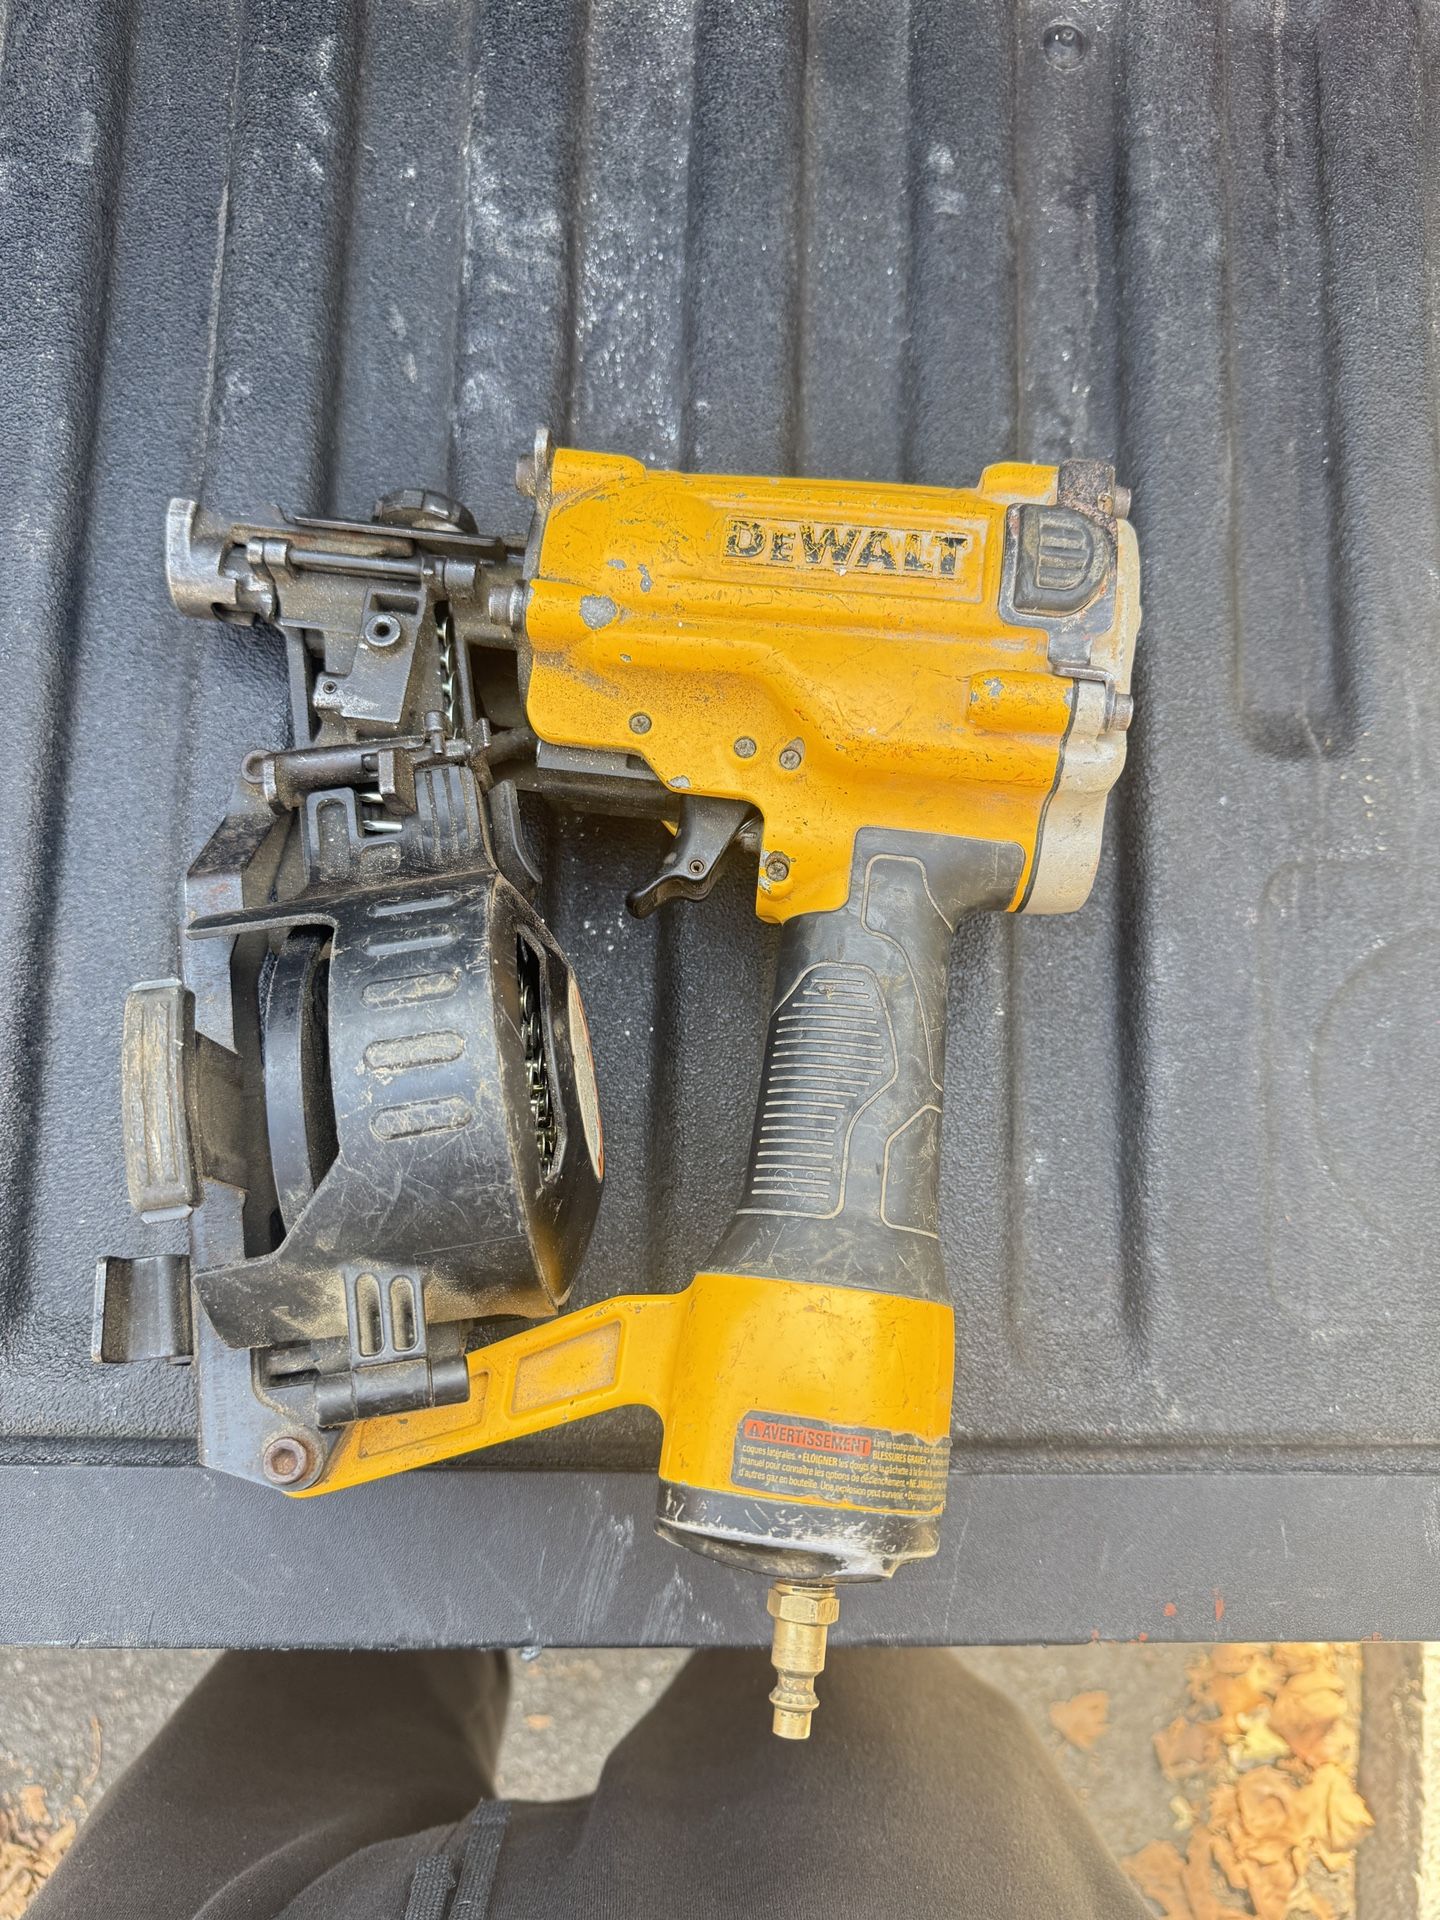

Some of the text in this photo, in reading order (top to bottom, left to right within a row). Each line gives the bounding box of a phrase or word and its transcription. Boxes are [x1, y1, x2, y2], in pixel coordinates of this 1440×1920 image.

[762, 1424, 868, 1454] AVERTISSEMENT
[742, 1445, 766, 1456] coques
[850, 1460, 869, 1473] doigts
[870, 1462, 878, 1472] de
[873, 1450, 906, 1463] BLESSURES
[740, 1457, 765, 1467] manuel
[766, 1461, 780, 1470] pour
[782, 1464, 813, 1475] connaître
[814, 1467, 824, 1477] les
[825, 1471, 850, 1481] options
[851, 1473, 859, 1482] de
[766, 1474, 778, 1483] gaz
[779, 1476, 788, 1484] en
[820, 1480, 834, 1491] Une
